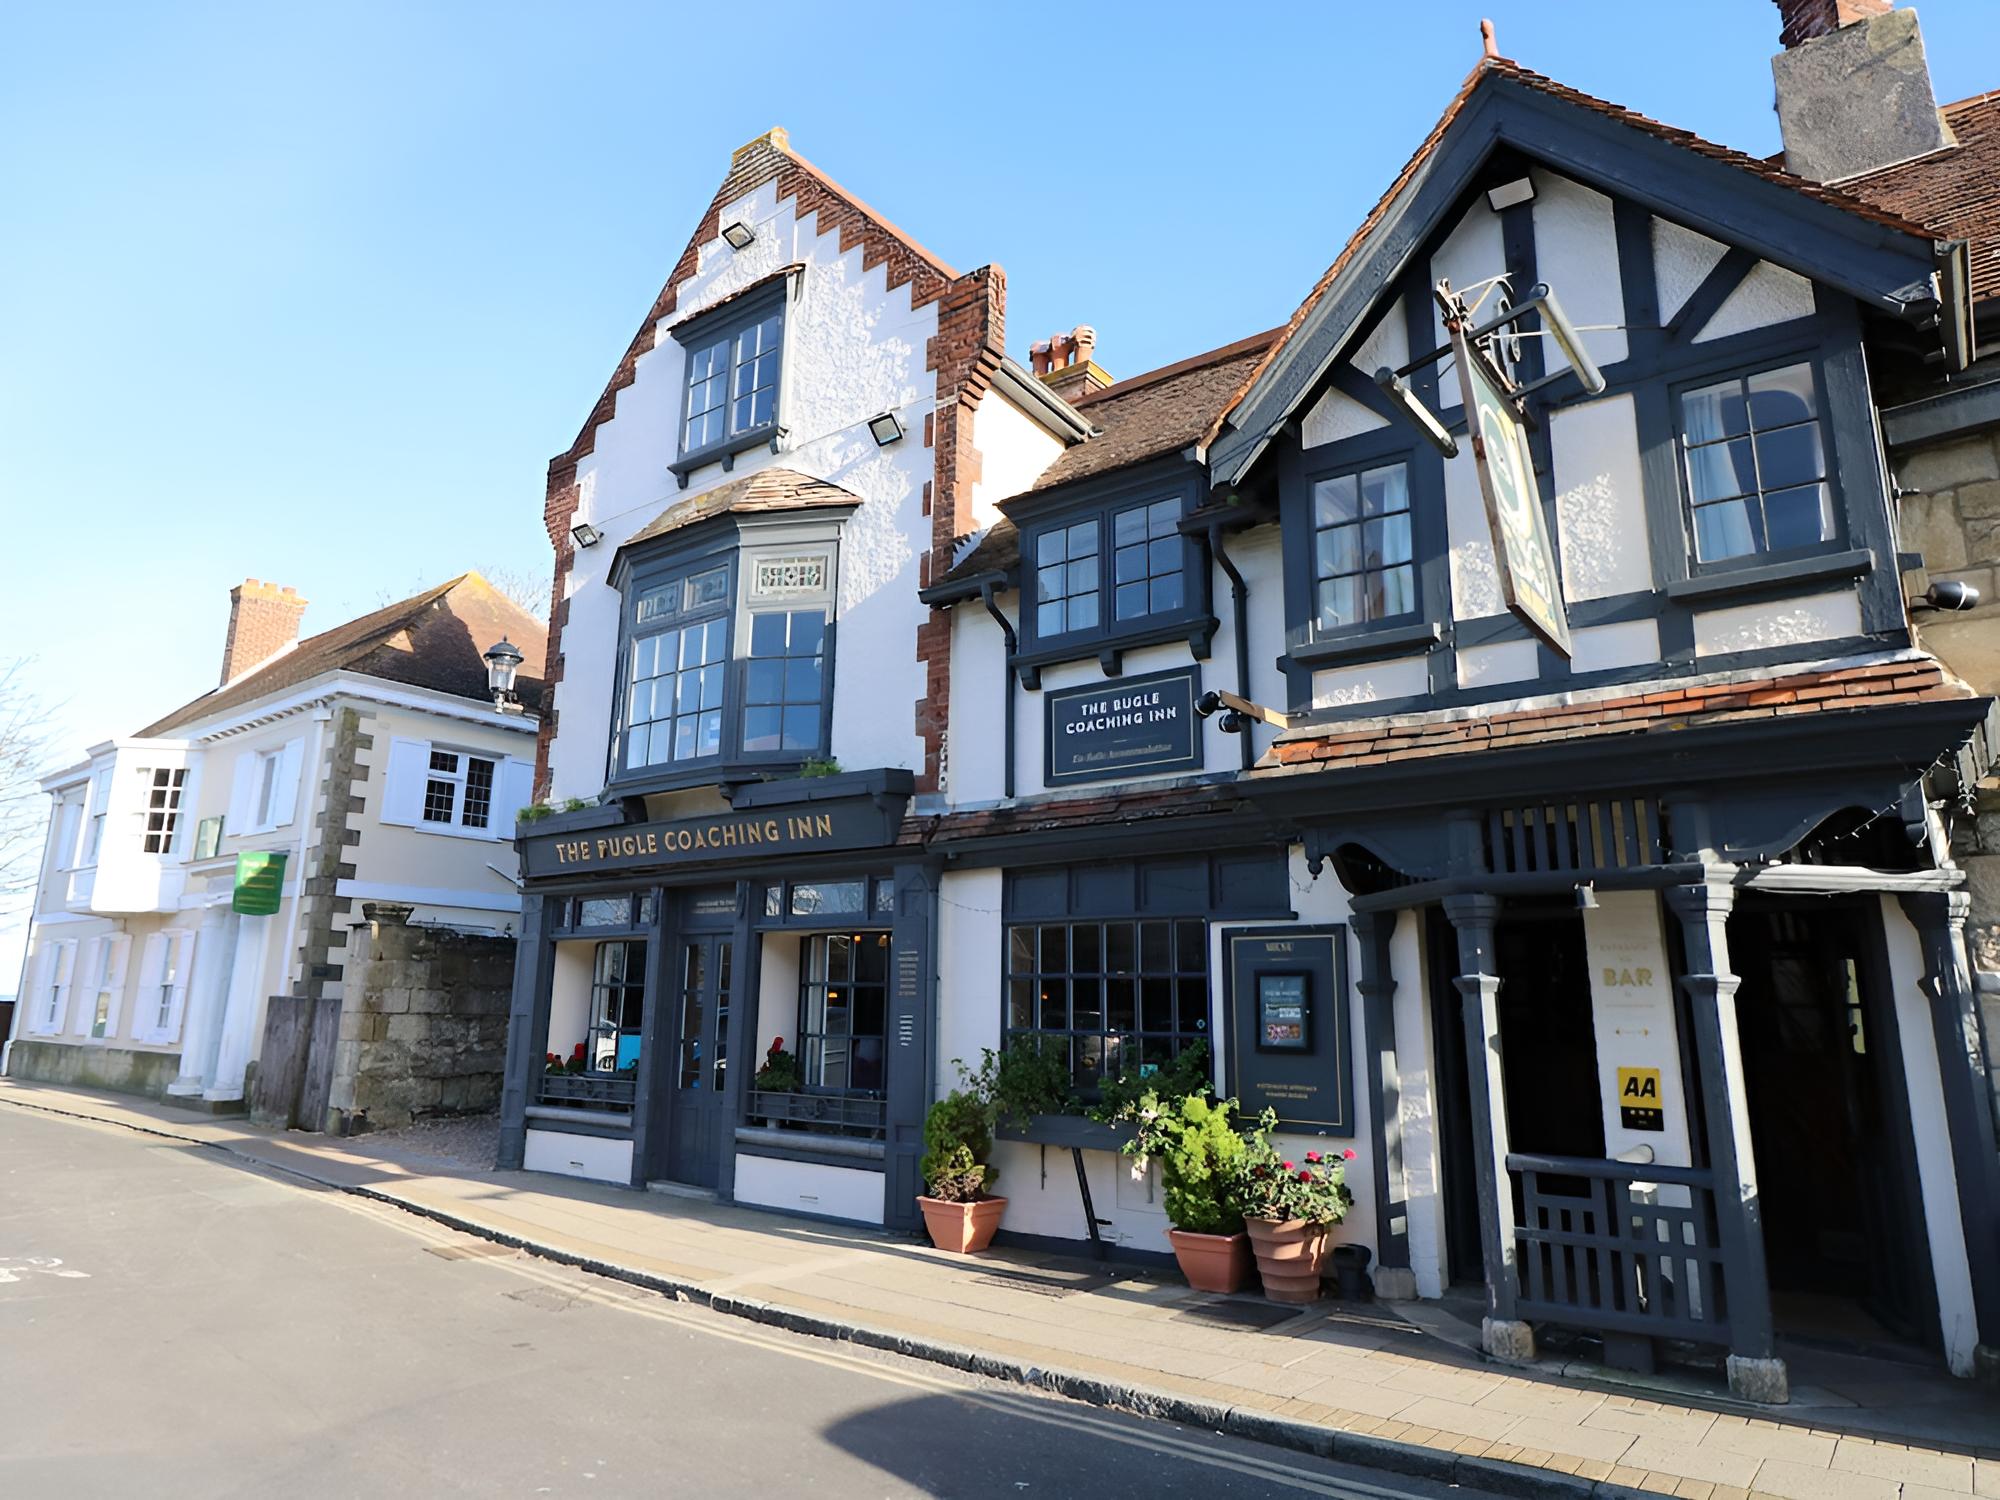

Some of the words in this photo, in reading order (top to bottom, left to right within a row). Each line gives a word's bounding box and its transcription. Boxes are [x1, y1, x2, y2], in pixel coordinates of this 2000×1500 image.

[1081, 701, 1107, 716] THE
[1113, 692, 1160, 711] BUGLE
[1066, 712, 1143, 734] COACHING
[1149, 706, 1177, 722] INN
[556, 841, 591, 864] THE
[664, 820, 780, 852] COACHING
[787, 814, 833, 840] INN
[1603, 967, 1653, 987] BAR
[1624, 1076, 1656, 1098] AA
